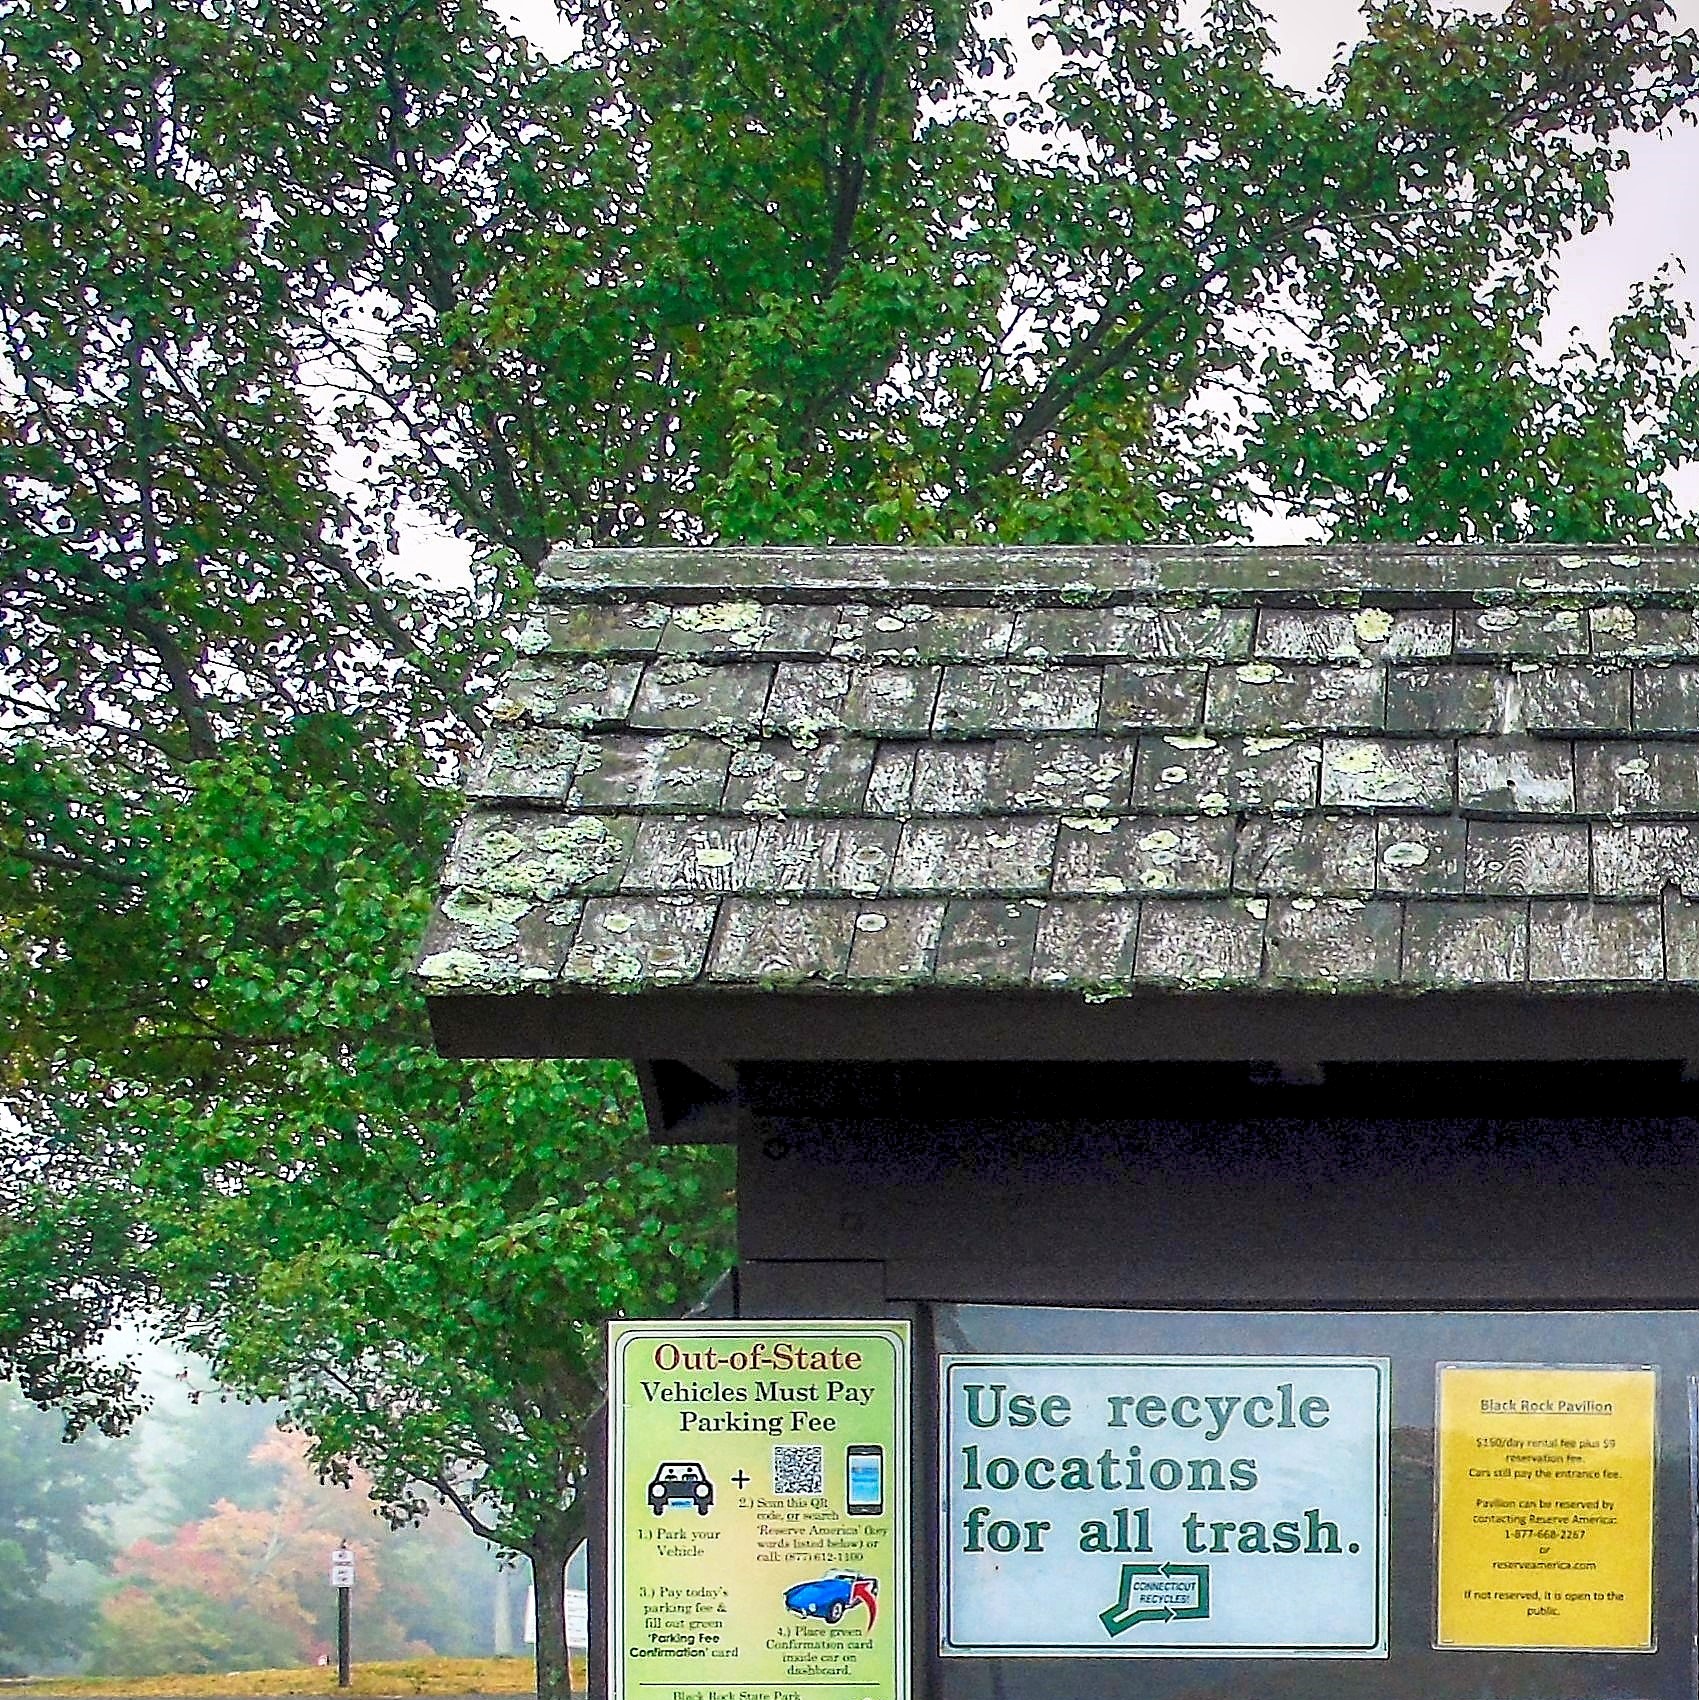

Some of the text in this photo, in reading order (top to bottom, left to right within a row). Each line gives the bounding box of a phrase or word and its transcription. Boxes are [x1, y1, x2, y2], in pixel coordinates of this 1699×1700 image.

[655, 1344, 861, 1370] Out-of-State
[640, 1382, 747, 1401] Vehicles
[755, 1382, 819, 1401] Must
[963, 1384, 1329, 1441] Use recycle
[962, 1445, 1257, 1490] locations
[787, 1498, 807, 1507] this
[639, 1529, 652, 1540] 1.)
[963, 1507, 1359, 1553] for all trash.
[1133, 1581, 1196, 1591] CONNECTICUT
[717, 1603, 727, 1612] &
